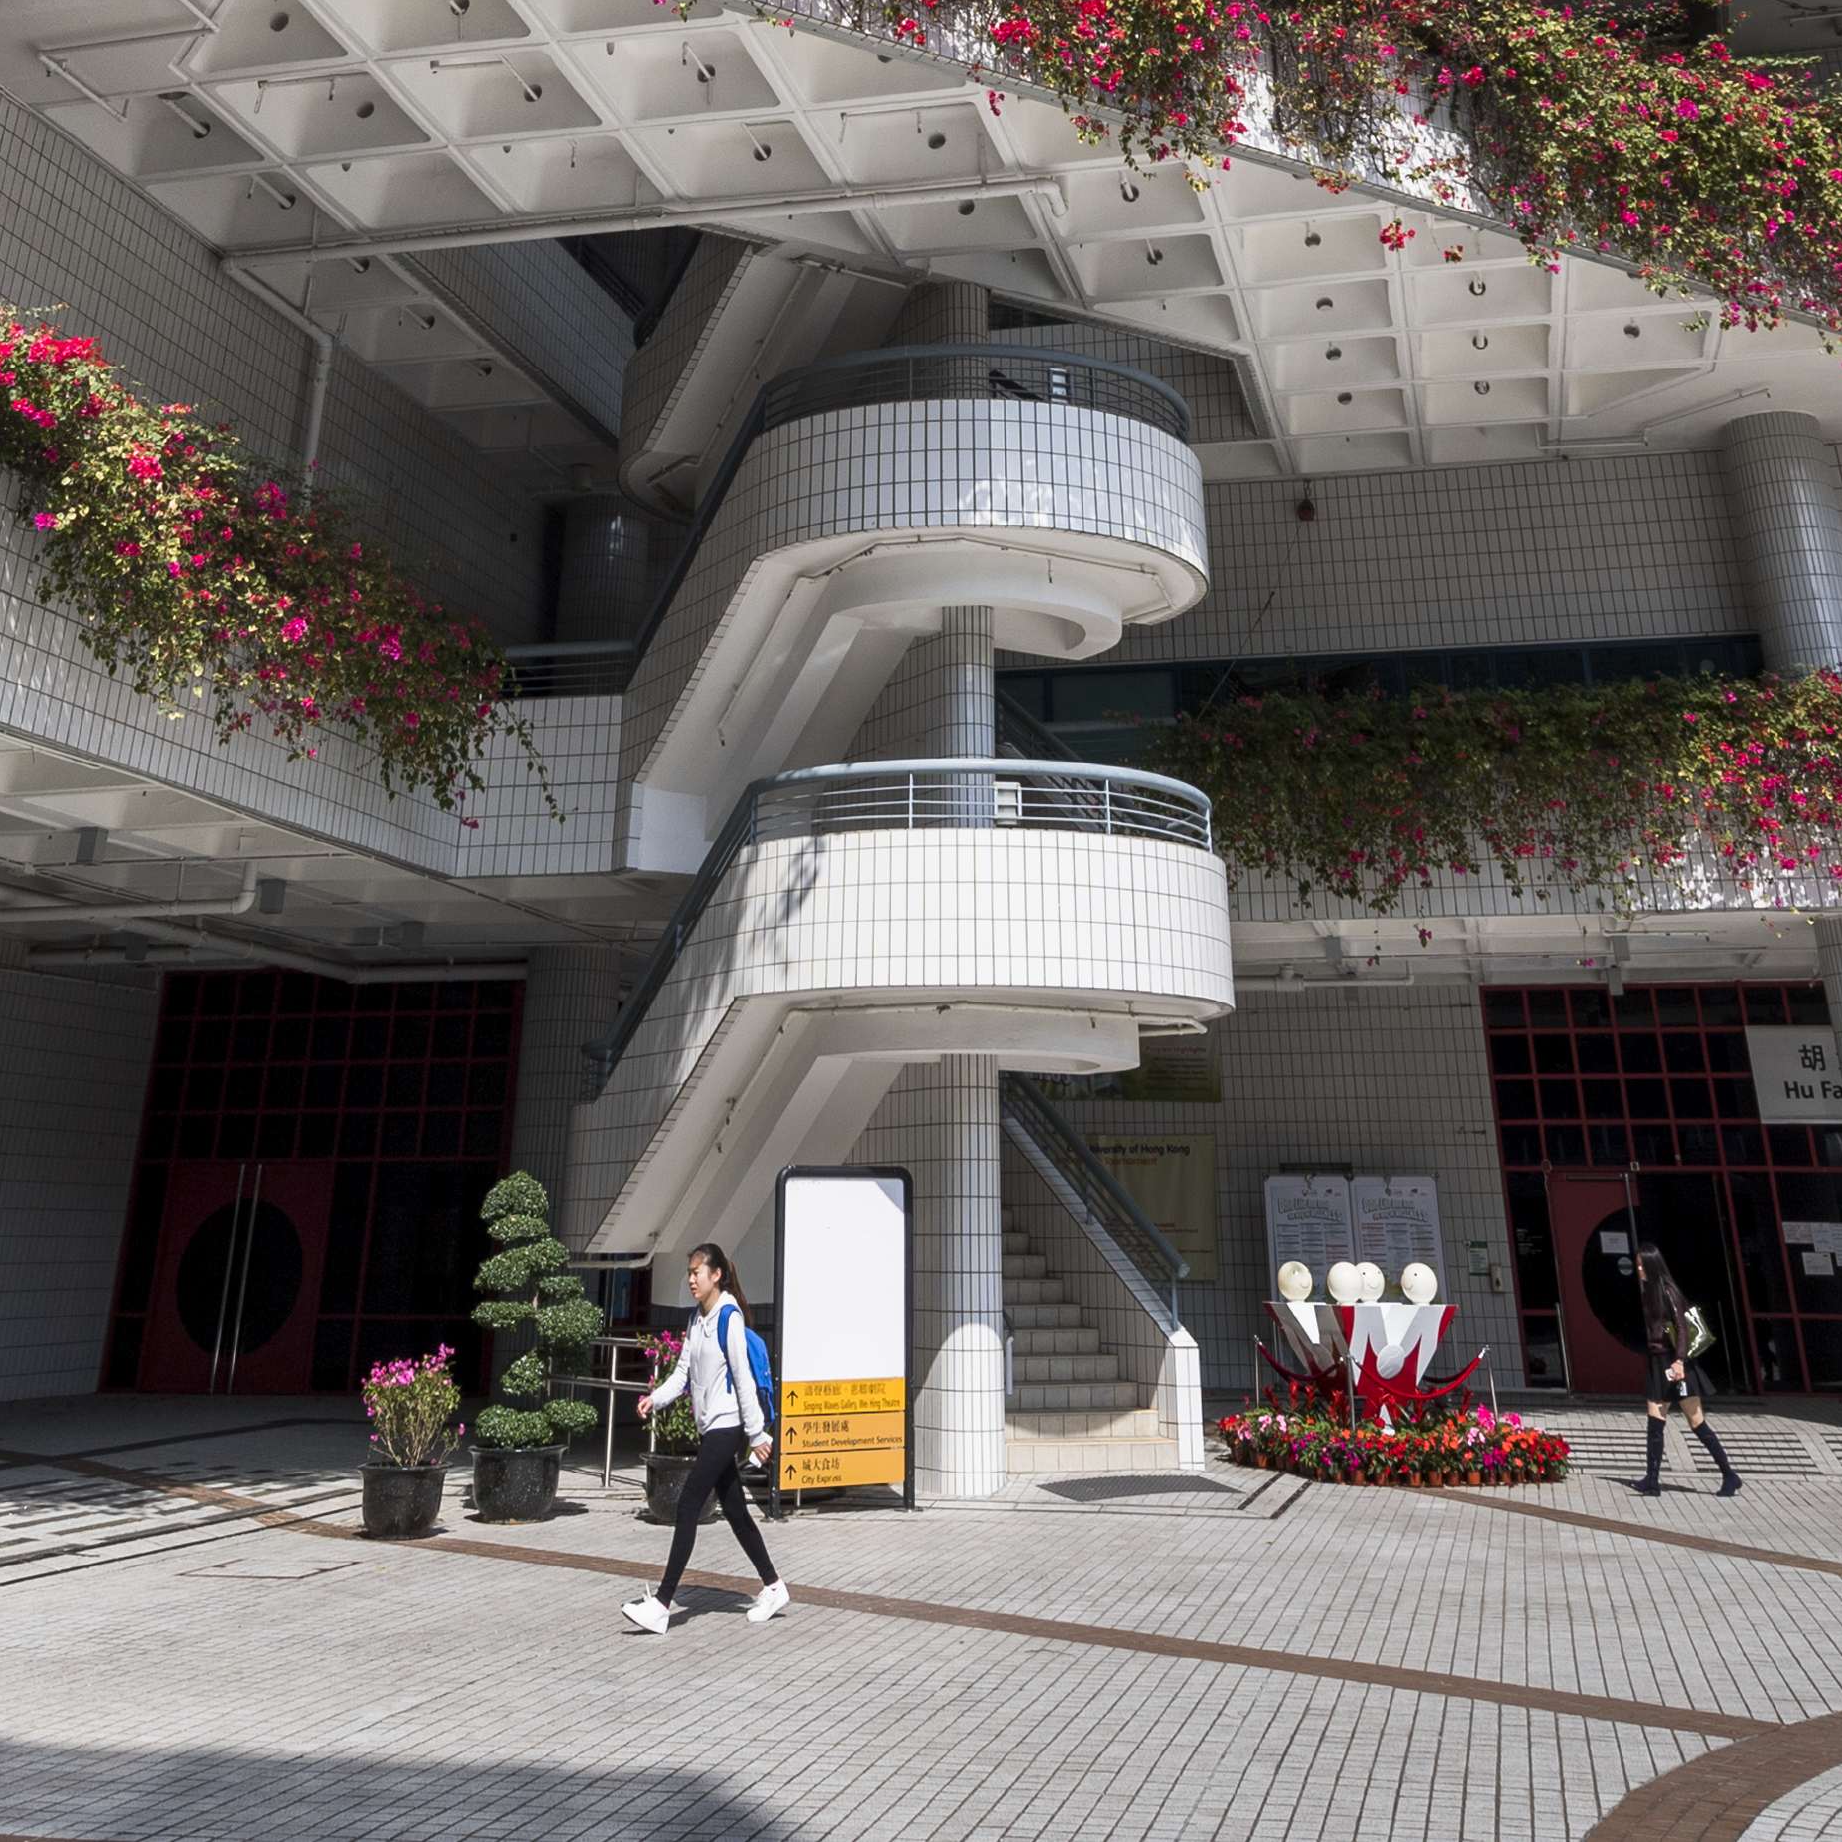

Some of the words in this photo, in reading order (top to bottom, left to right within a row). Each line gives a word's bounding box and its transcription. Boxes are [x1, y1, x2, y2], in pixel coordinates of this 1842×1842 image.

[1783, 1080, 1815, 1099] Hu
[802, 1437, 829, 1447] Student
[830, 1436, 875, 1447] Development
[876, 1435, 903, 1444] Services
[801, 1475, 815, 1485] City
